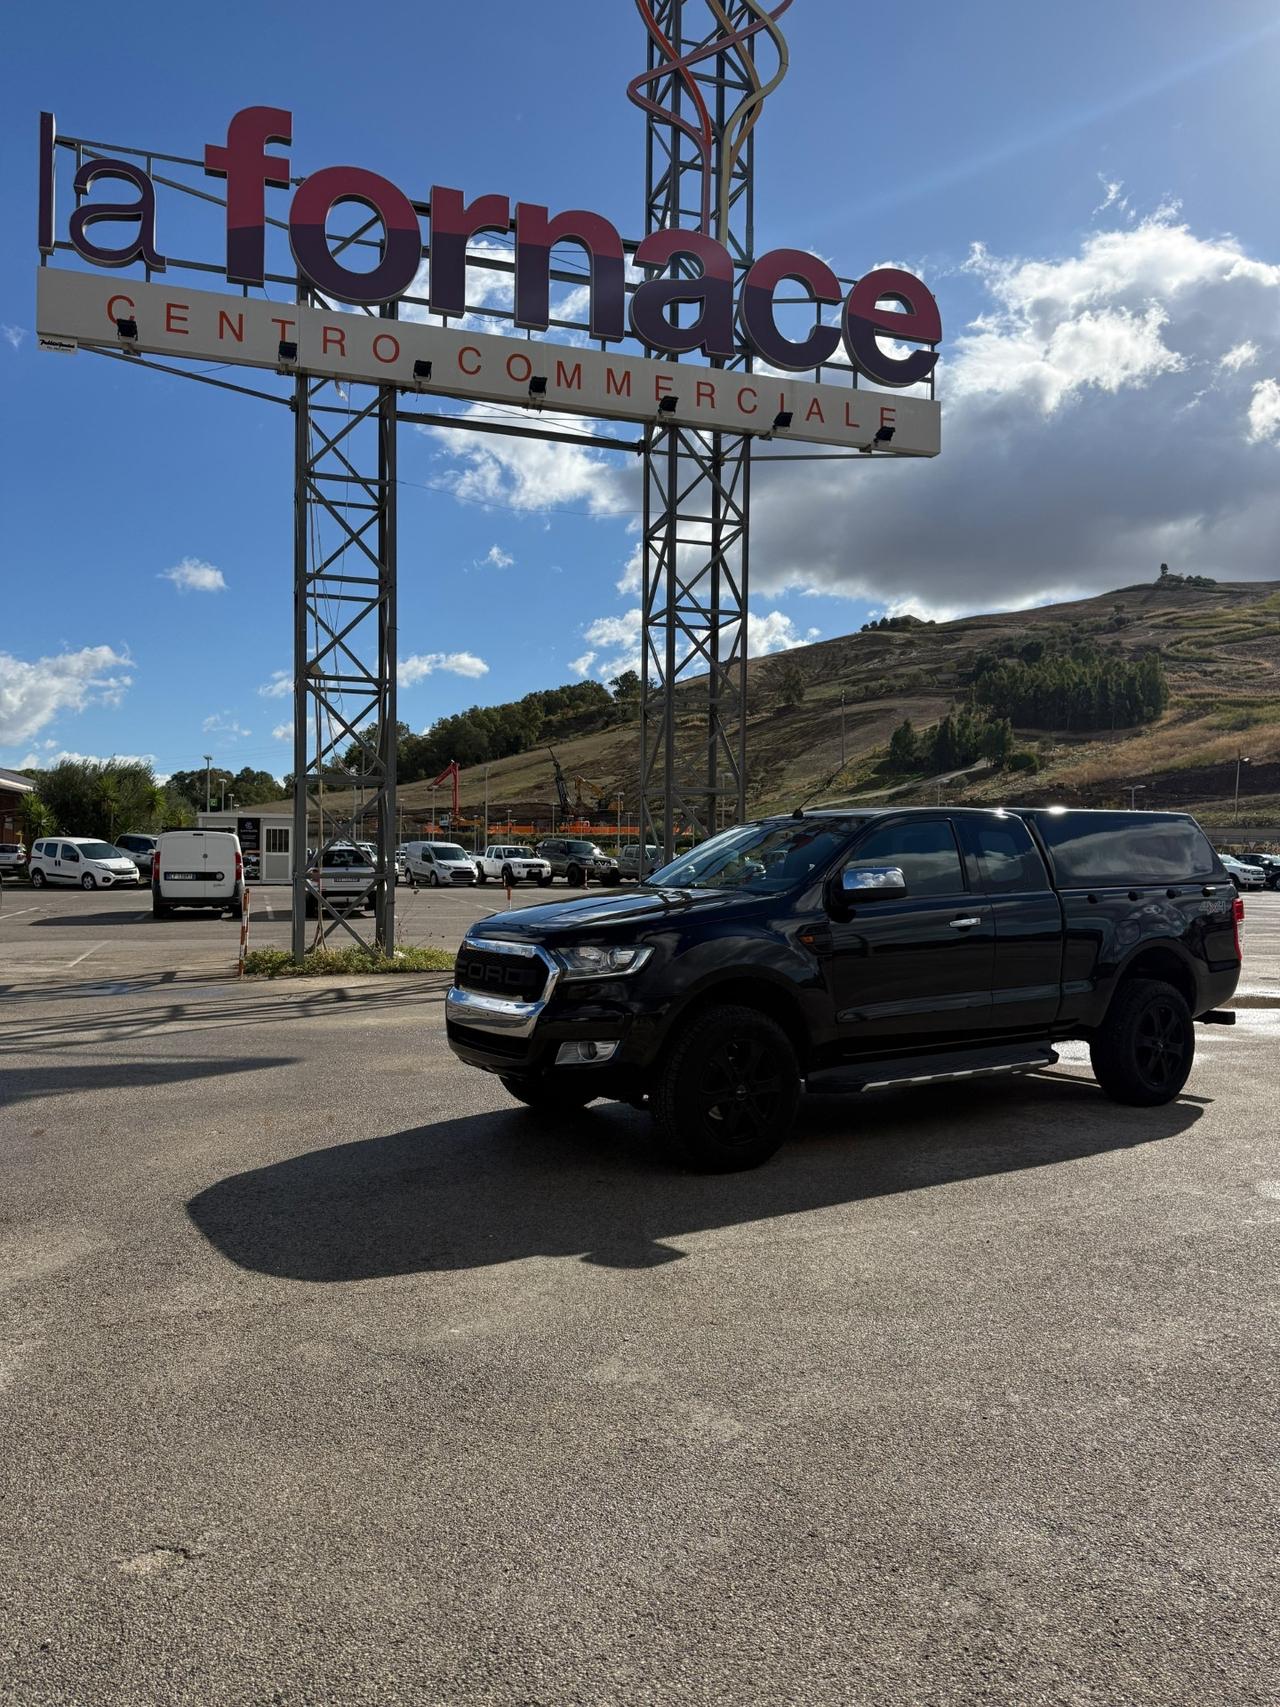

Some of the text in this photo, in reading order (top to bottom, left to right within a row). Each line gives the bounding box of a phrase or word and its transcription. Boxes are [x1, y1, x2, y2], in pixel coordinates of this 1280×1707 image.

[39, 106, 942, 388] la fornace
[107, 294, 896, 429] CENTRO COMMERCIALE
